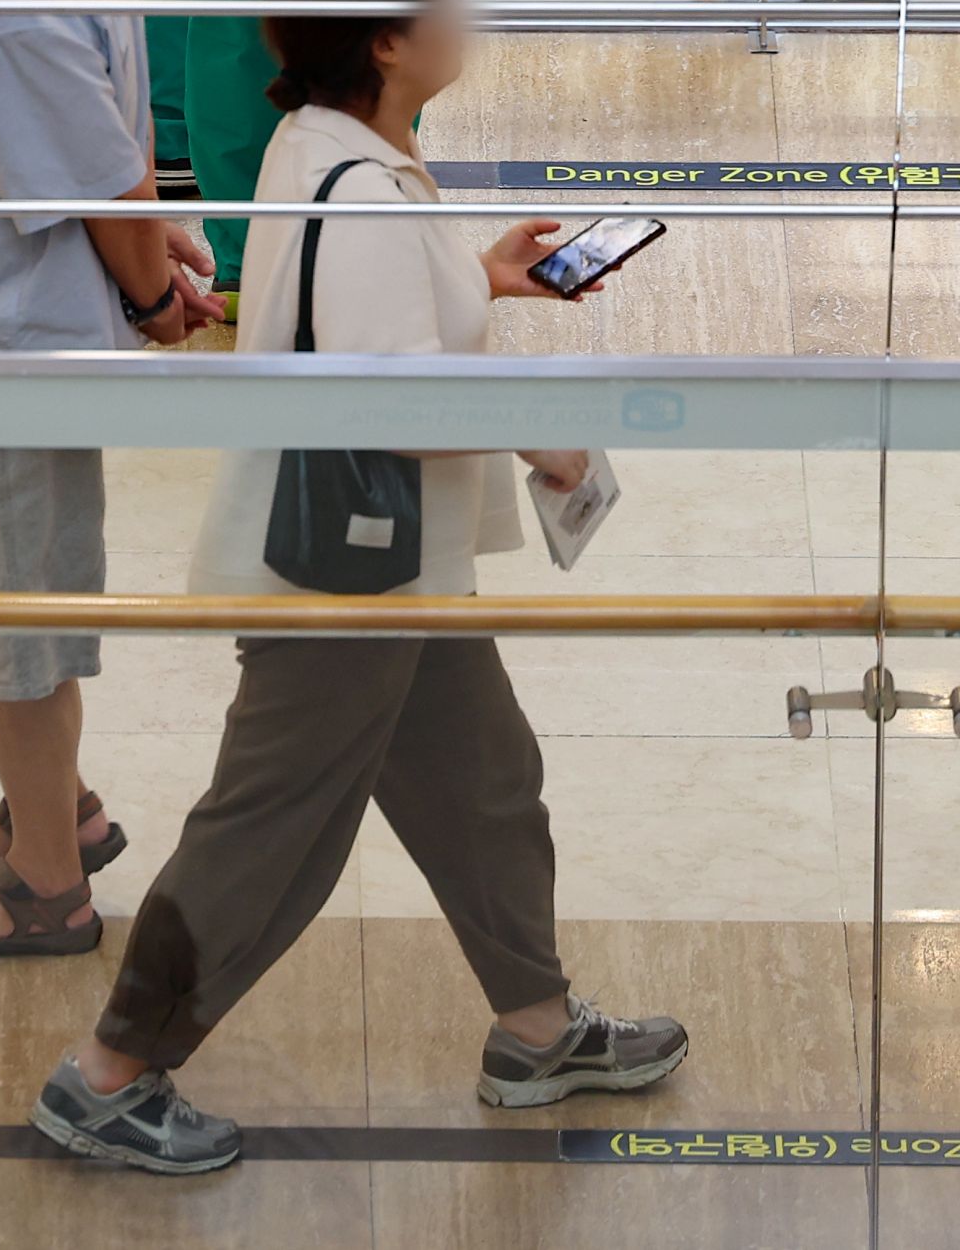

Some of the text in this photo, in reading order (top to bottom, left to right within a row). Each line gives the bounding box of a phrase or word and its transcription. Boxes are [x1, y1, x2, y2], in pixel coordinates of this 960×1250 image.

[546, 166, 705, 186] Danger
[720, 166, 828, 183] Zone
[609, 1133, 838, 1158] (위험구역)
